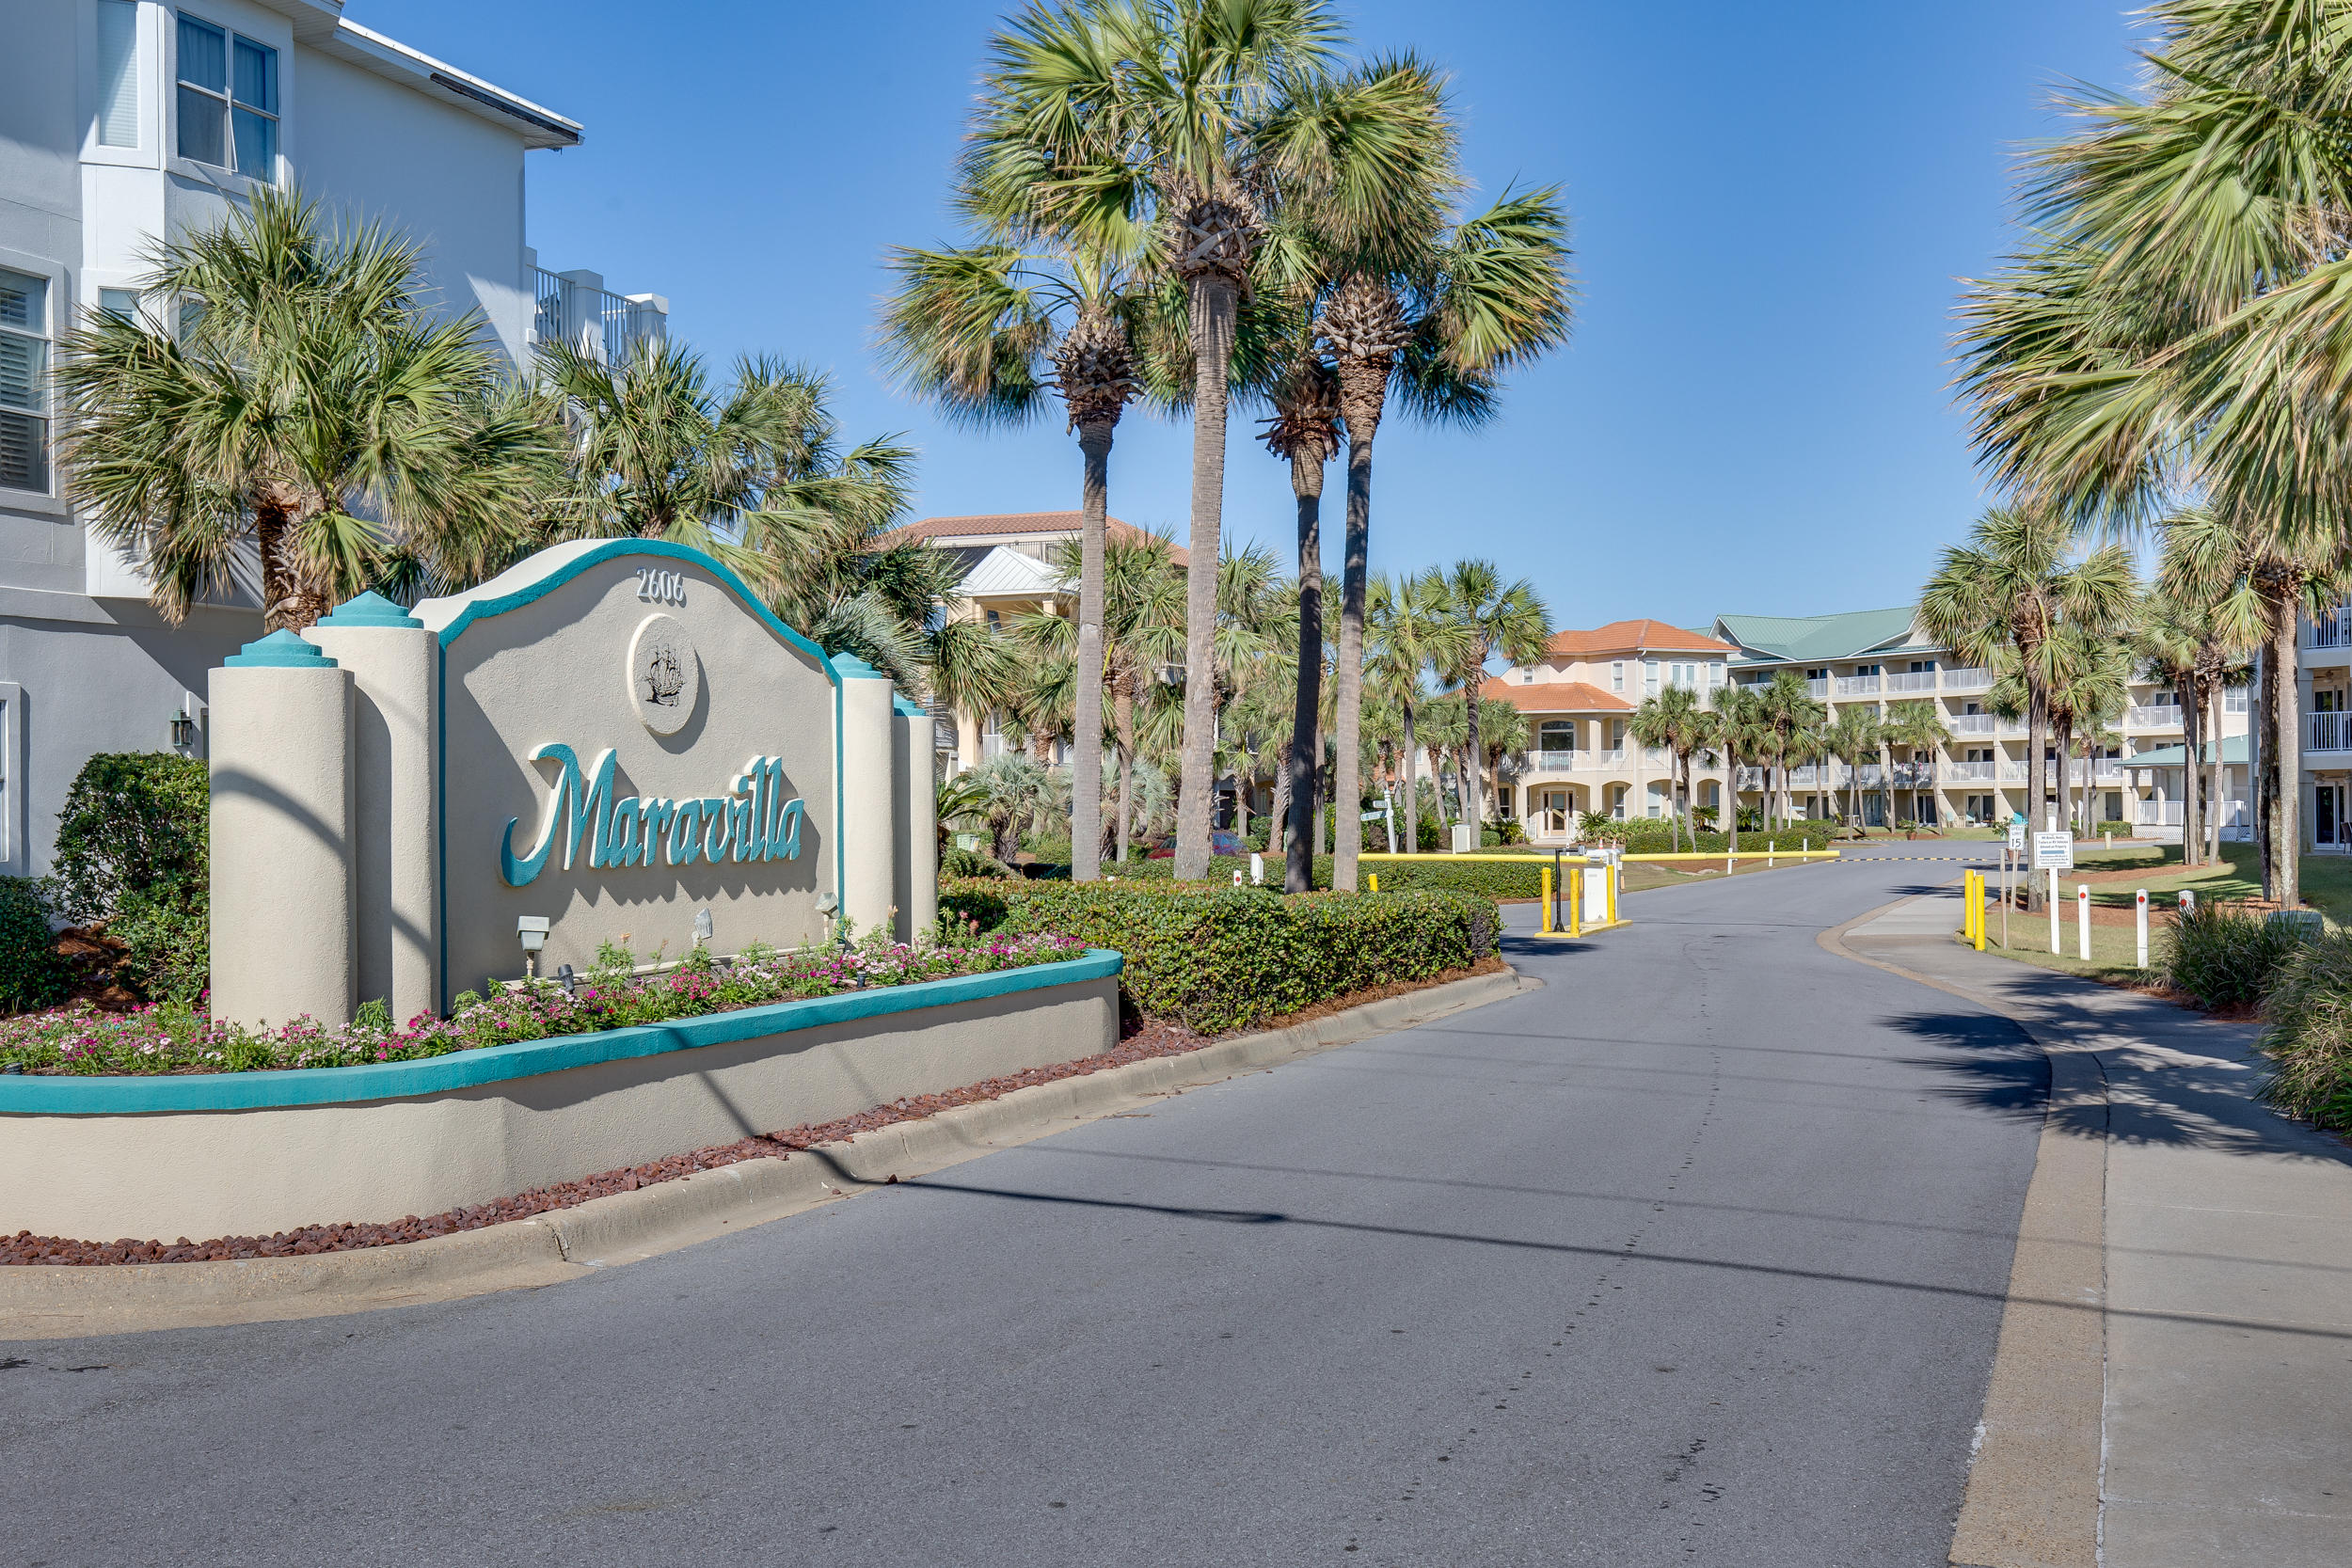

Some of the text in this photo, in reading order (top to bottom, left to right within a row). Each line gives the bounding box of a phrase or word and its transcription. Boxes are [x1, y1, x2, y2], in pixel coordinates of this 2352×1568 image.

[636, 567, 683, 602] 2606
[501, 742, 804, 887] Maravilla
[2011, 838, 2022, 847] 15
